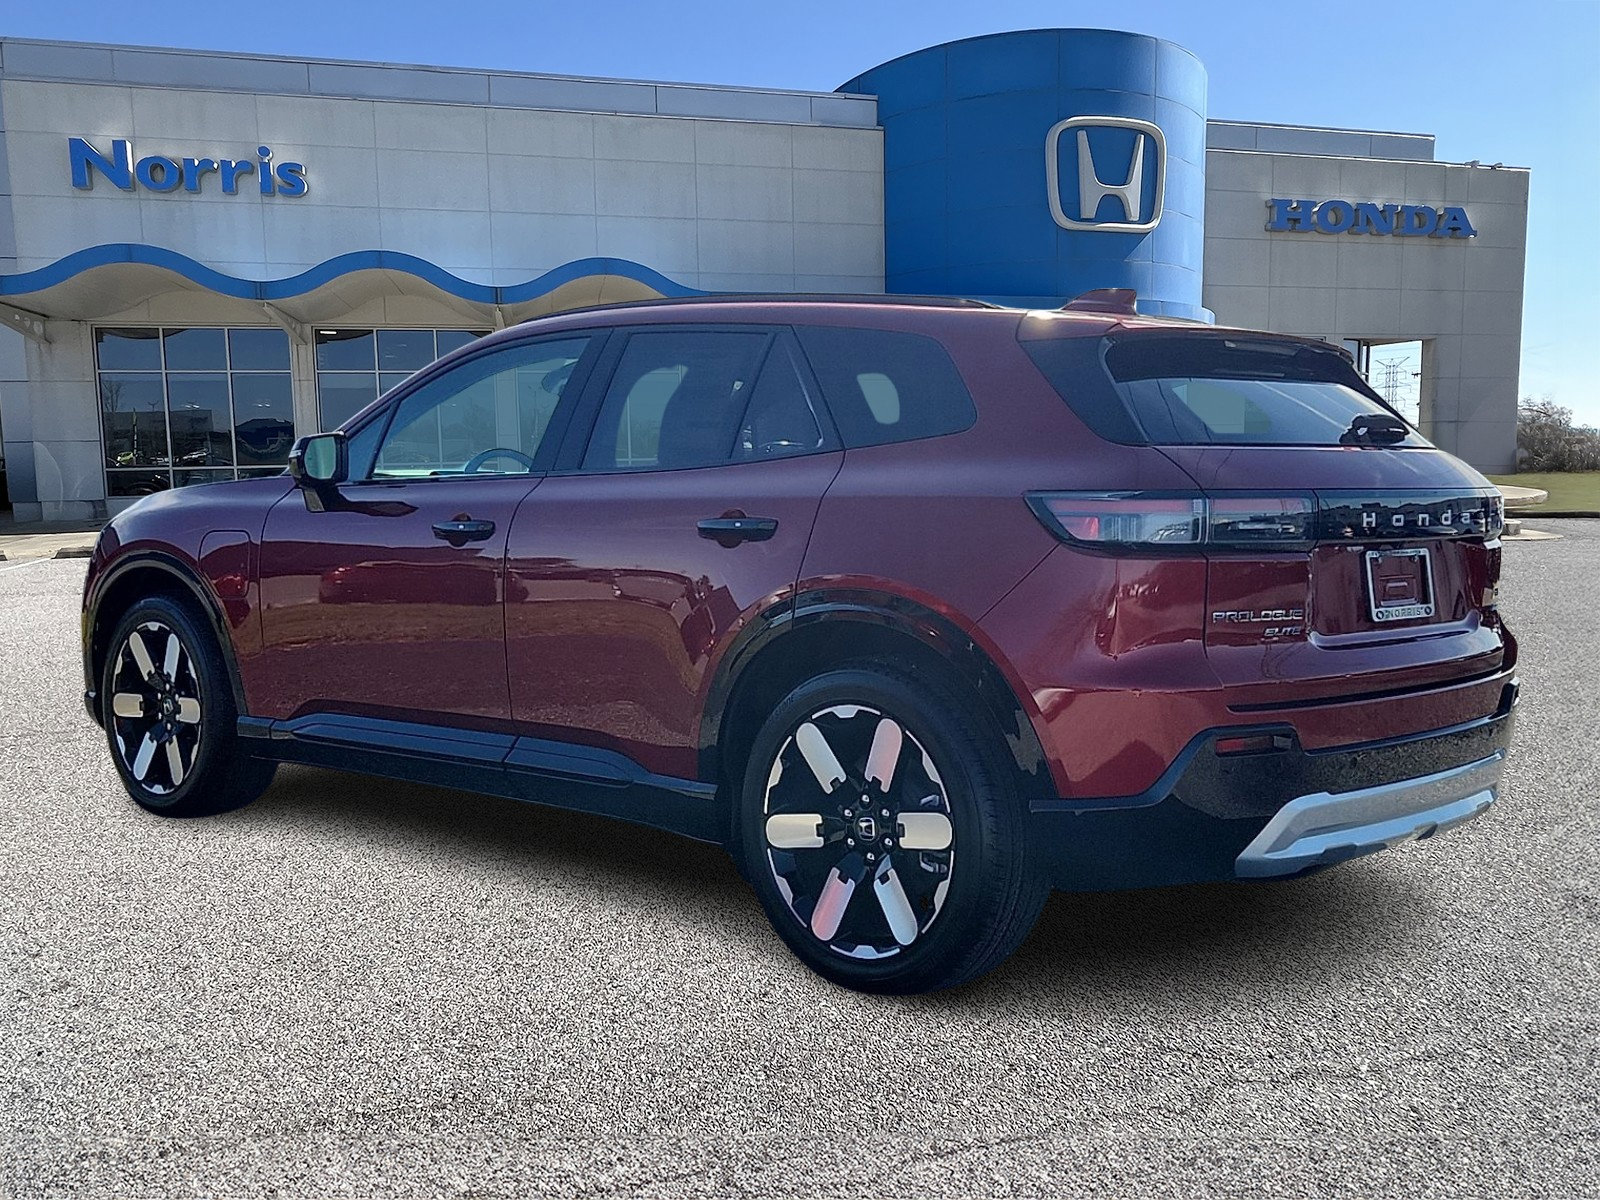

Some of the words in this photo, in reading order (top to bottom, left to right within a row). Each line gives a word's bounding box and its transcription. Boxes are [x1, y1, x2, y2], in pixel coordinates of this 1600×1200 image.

[68, 137, 309, 197] Norris
[1265, 198, 1477, 239] HONDA
[1362, 509, 1471, 528] Honda
[1212, 609, 1303, 623] PROLOGUE
[1385, 607, 1421, 619] NORRIS
[1264, 626, 1301, 636] ELITE
